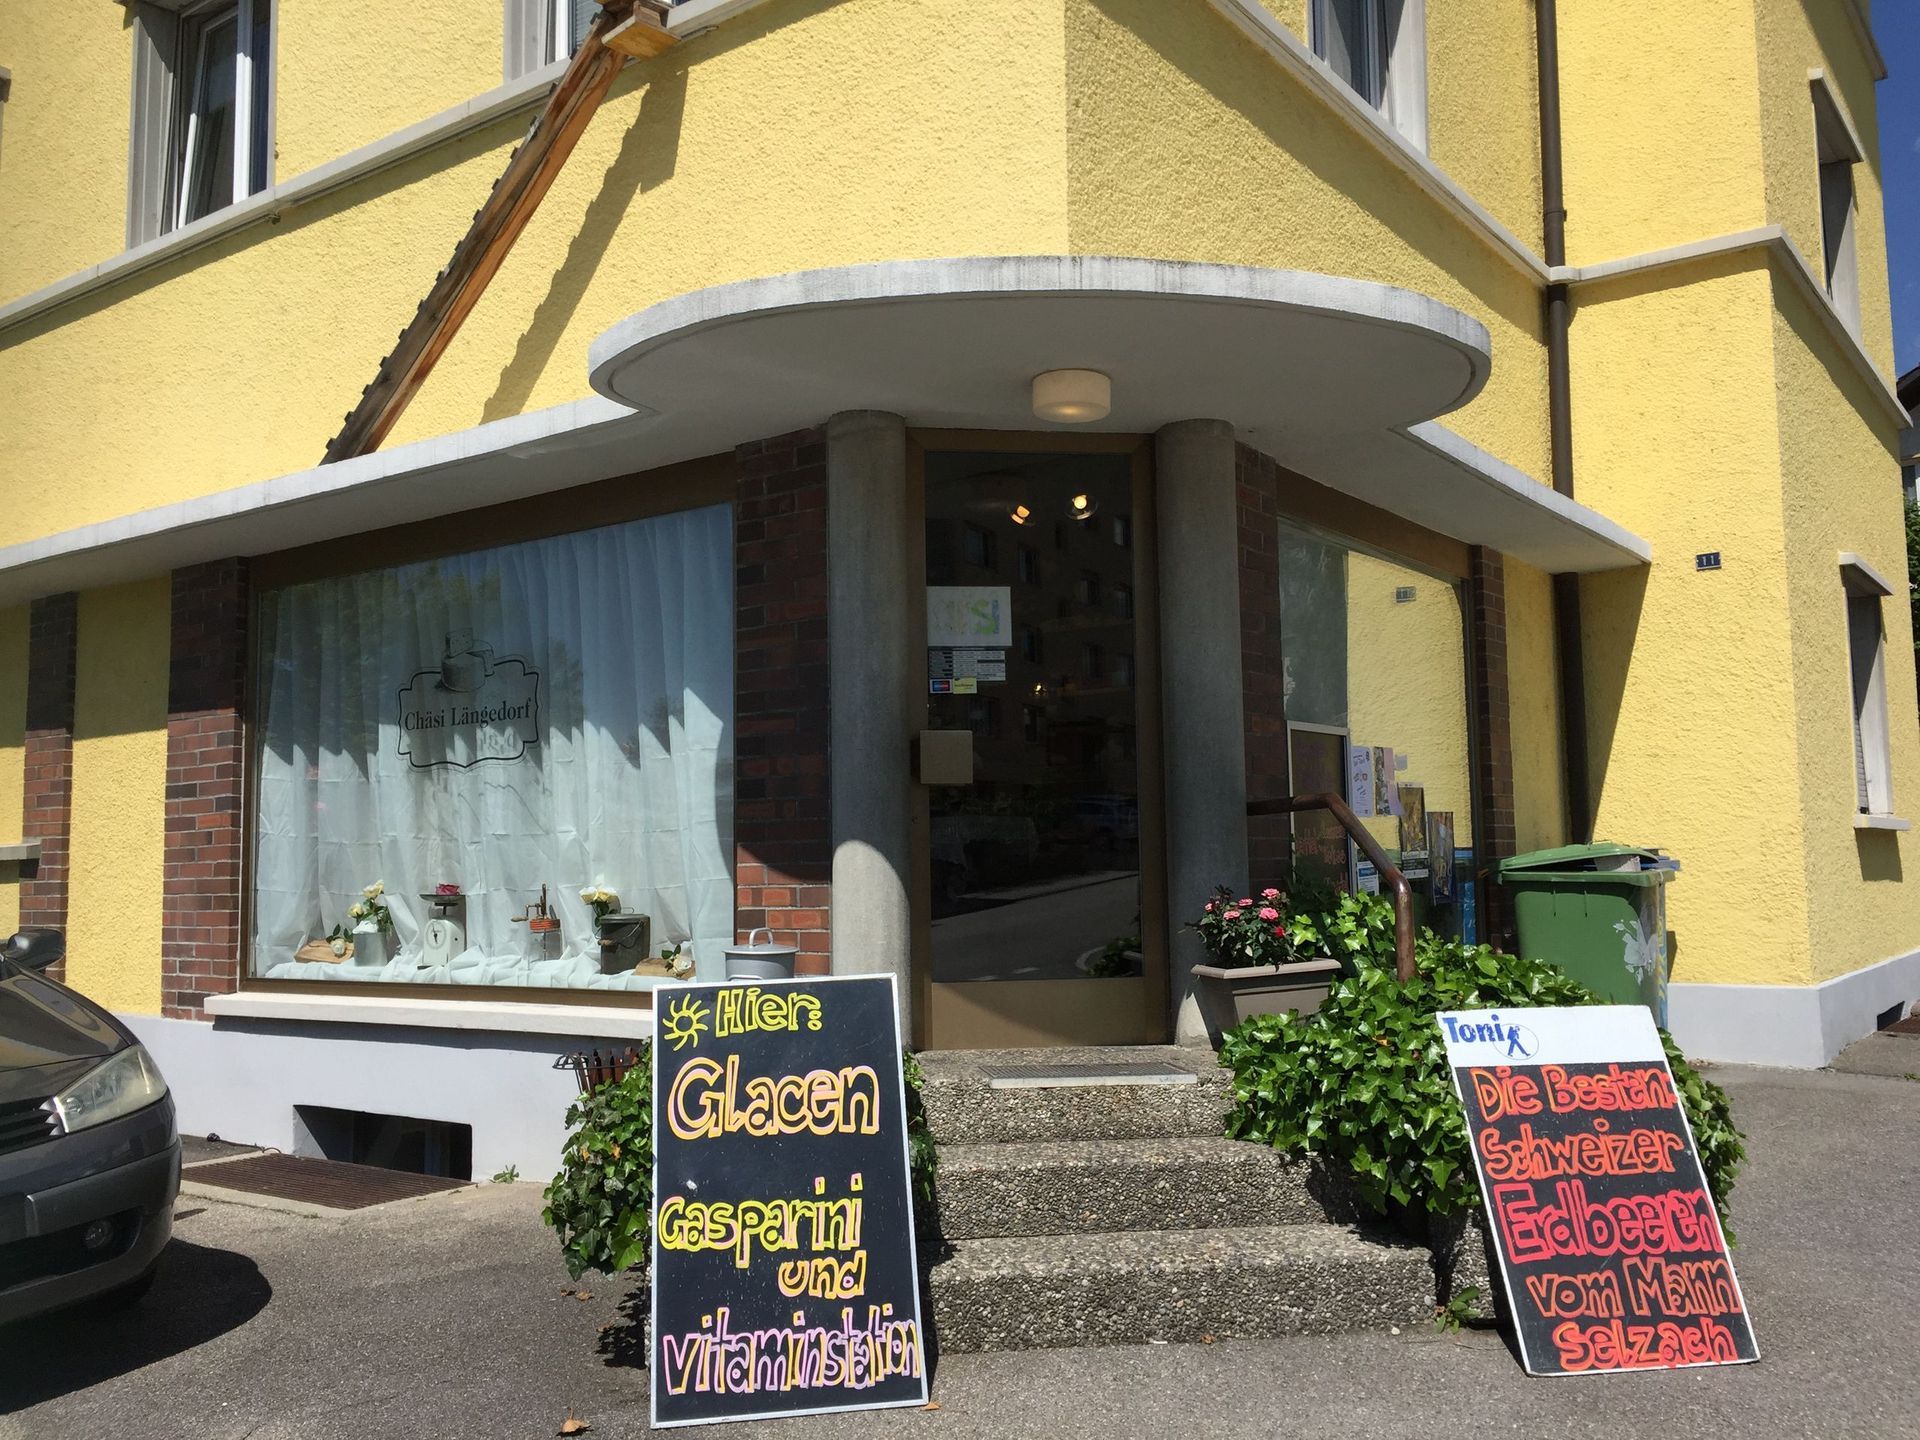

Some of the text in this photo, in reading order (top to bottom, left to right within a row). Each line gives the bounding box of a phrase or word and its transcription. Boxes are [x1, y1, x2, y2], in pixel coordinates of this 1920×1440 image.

[404, 697, 532, 731] Chäsi Längedorf
[715, 987, 823, 1037] Hier:
[1442, 1014, 1505, 1043] Toni
[667, 1054, 880, 1141] Glacen
[1470, 1065, 1544, 1123] Die
[1479, 1118, 1685, 1181] Schweizer
[659, 1173, 863, 1269] Gasparini
[1493, 1179, 1726, 1264] Erdbeeren
[778, 1250, 867, 1300] und
[1526, 1256, 1744, 1319] vom Mann
[1552, 1317, 1739, 1372] Selzach
